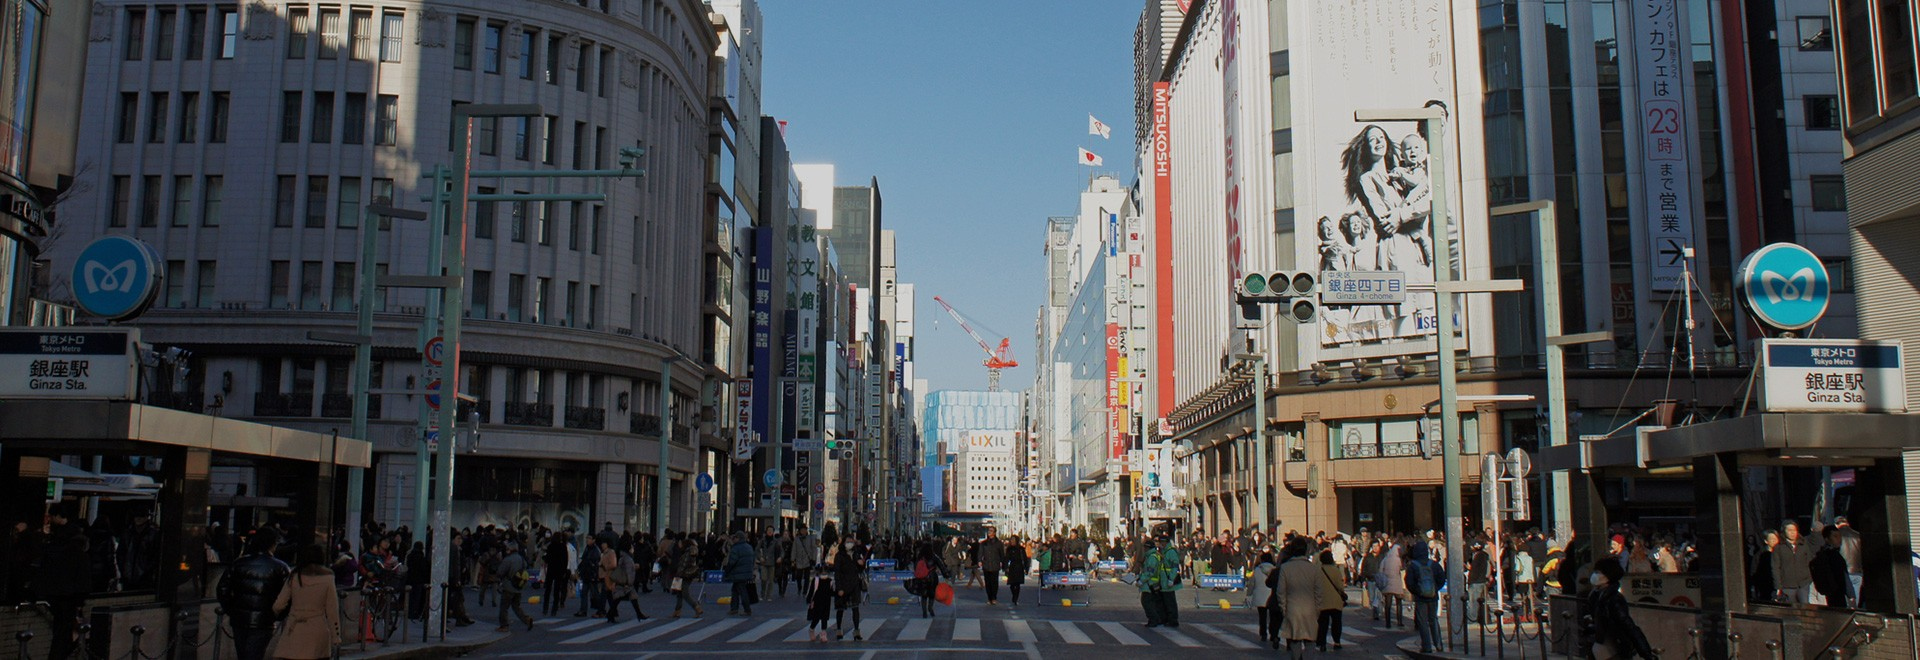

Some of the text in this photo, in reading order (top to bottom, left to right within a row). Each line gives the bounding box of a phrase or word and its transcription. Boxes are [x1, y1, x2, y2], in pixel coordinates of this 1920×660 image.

[1426, 2, 1444, 93] べてが動く。
[1156, 88, 1168, 177] MITSUKOSHI
[800, 224, 816, 311] 教文館
[1328, 279, 1401, 292] 銀座四丁目
[1336, 292, 1394, 300] Ginza 4-chome
[755, 268, 770, 348] 山野楽器
[39, 335, 85, 344] 東京メトロ
[41, 345, 60, 353] Tokyo
[1810, 348, 1856, 357] 東京メトロ
[1814, 358, 1833, 366] Tokyo
[30, 360, 89, 378] 銀座駅
[30, 379, 87, 390] Ginza Sta.
[1805, 373, 1865, 391] 銀座駅
[1807, 392, 1866, 403] Ginza Sta.
[738, 399, 750, 455] キムラヤのパン
[971, 434, 1006, 448] LIXIL
